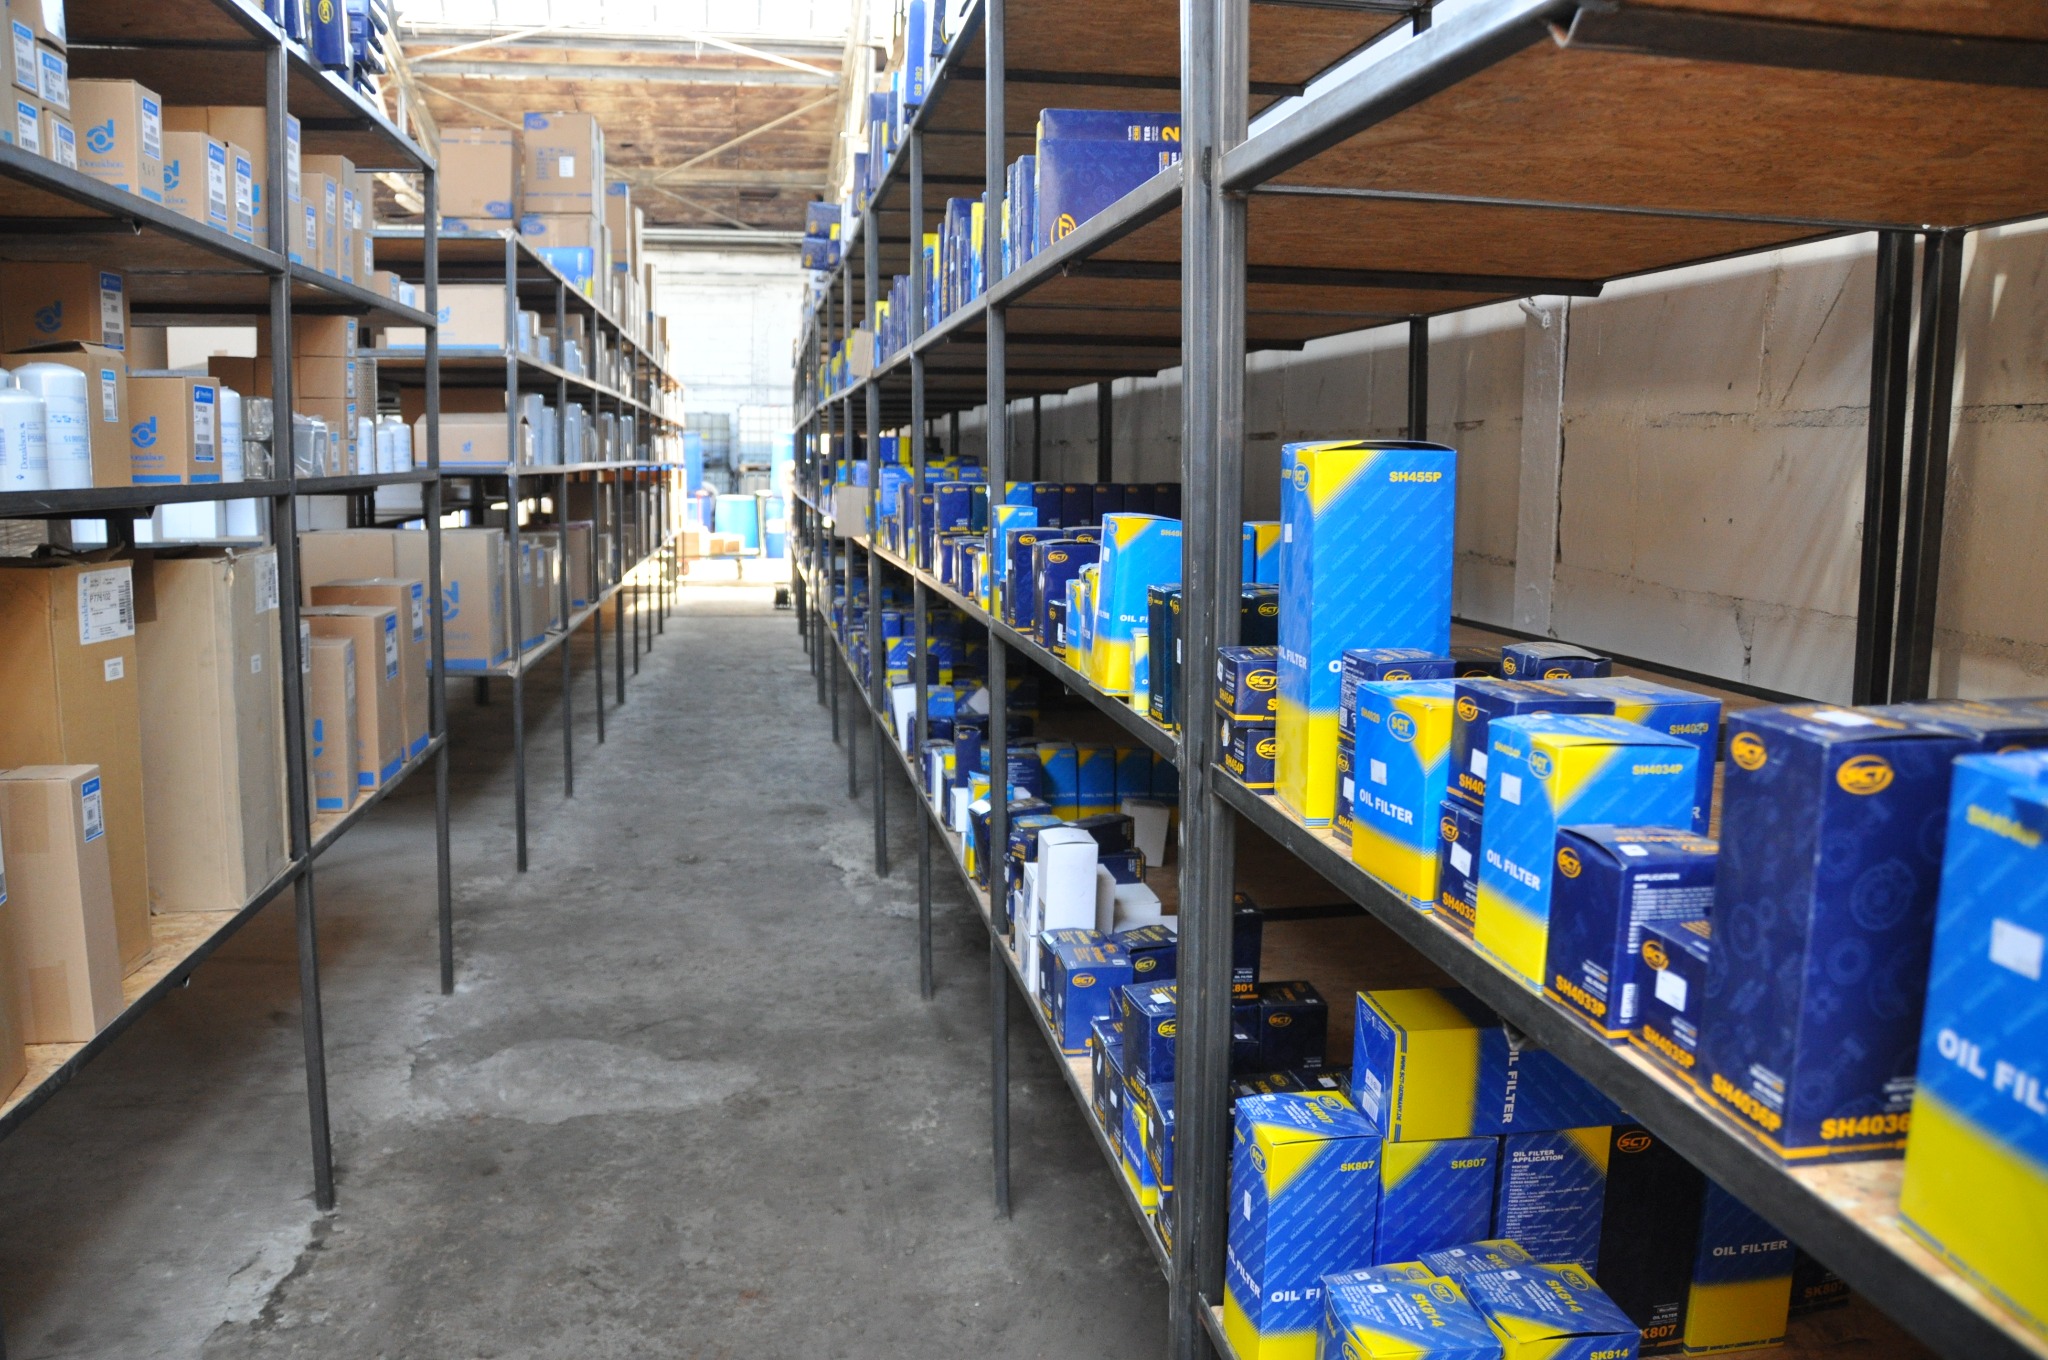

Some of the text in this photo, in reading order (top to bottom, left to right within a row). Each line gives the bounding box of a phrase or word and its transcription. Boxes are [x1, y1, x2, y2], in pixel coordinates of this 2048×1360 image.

[1294, 470, 1306, 482] SCT
[1389, 471, 1443, 483] SH455P
[1286, 649, 1308, 670] FILTER
[1504, 662, 1516, 672] SCT
[1250, 676, 1278, 685] SCT
[1458, 702, 1476, 716] SCT
[1391, 716, 1410, 733] SCT
[1259, 744, 1276, 752] SC
[1533, 754, 1548, 772] SCT
[1632, 764, 1683, 776] SH4034P
[1360, 788, 1414, 826] OIL FILTER
[1442, 822, 1458, 837] SCT
[1486, 848, 1541, 892] OIL FILTER
[1442, 892, 1476, 922] SH4032
[1137, 960, 1155, 968] SCT
[1074, 976, 1095, 984] SCT
[1232, 984, 1254, 993] 801
[1270, 1016, 1291, 1024] SCT
[1937, 1028, 2048, 1116] OIL FIL
[1502, 1051, 1519, 1124] IL FILTER
[1305, 1102, 1334, 1124] SK807
[1820, 1112, 1911, 1140] SH4036
[1620, 1136, 1648, 1147] SCT
[1252, 1147, 1264, 1166] SCT
[1512, 1154, 1564, 1163] APPLICATION
[1340, 1160, 1376, 1172] SK807
[1451, 1158, 1487, 1170] SK807
[1712, 1240, 1788, 1257] OIL FILTER
[1227, 1244, 1260, 1300] OIL FILTER
[1566, 1272, 1584, 1288] SCT
[1270, 1290, 1300, 1303] OIL
[1434, 1284, 1450, 1298] SCT
[1546, 1279, 1584, 1313] SK814
[1412, 1293, 1446, 1328] SK814
[1640, 1324, 1677, 1340] K807
[1590, 1348, 1630, 1360] SK814
